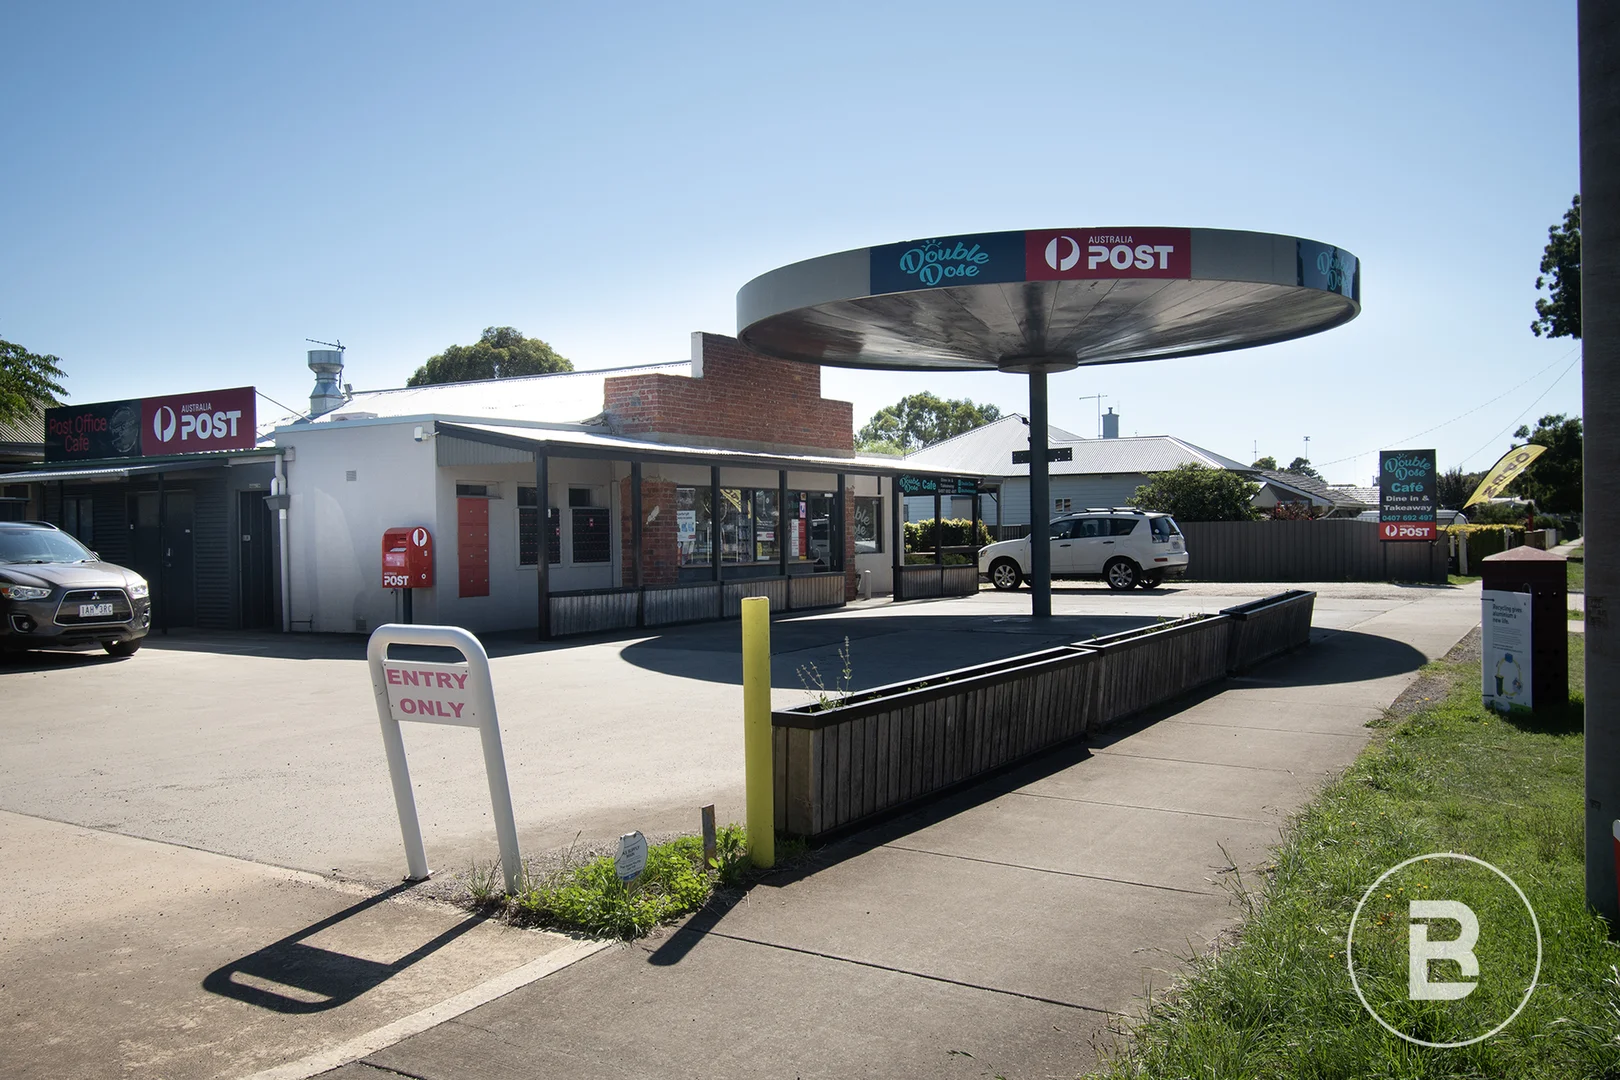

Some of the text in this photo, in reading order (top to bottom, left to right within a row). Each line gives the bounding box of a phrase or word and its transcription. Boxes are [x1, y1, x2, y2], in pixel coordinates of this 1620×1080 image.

[1088, 235, 1133, 244] AUSTRALIA
[900, 241, 989, 274] Double
[1088, 245, 1174, 270] POST
[919, 263, 980, 286] Dose
[181, 402, 212, 413] AUSTRALIA
[49, 413, 107, 436] Post Office
[181, 410, 242, 441] POST
[65, 434, 90, 452] Cafe
[1384, 455, 1431, 472] Double
[899, 475, 937, 490] Double Cafe
[1395, 467, 1426, 481] Dose
[1482, 452, 1530, 498] OPEN
[1391, 482, 1424, 493] Café
[854, 505, 870, 526] ble
[1383, 504, 1432, 512] Takeaway
[1399, 528, 1430, 537] POST
[383, 575, 409, 586] POST
[1492, 603, 1511, 613] Recycling
[386, 669, 468, 690] ENTRY
[399, 698, 465, 718] ONLY
